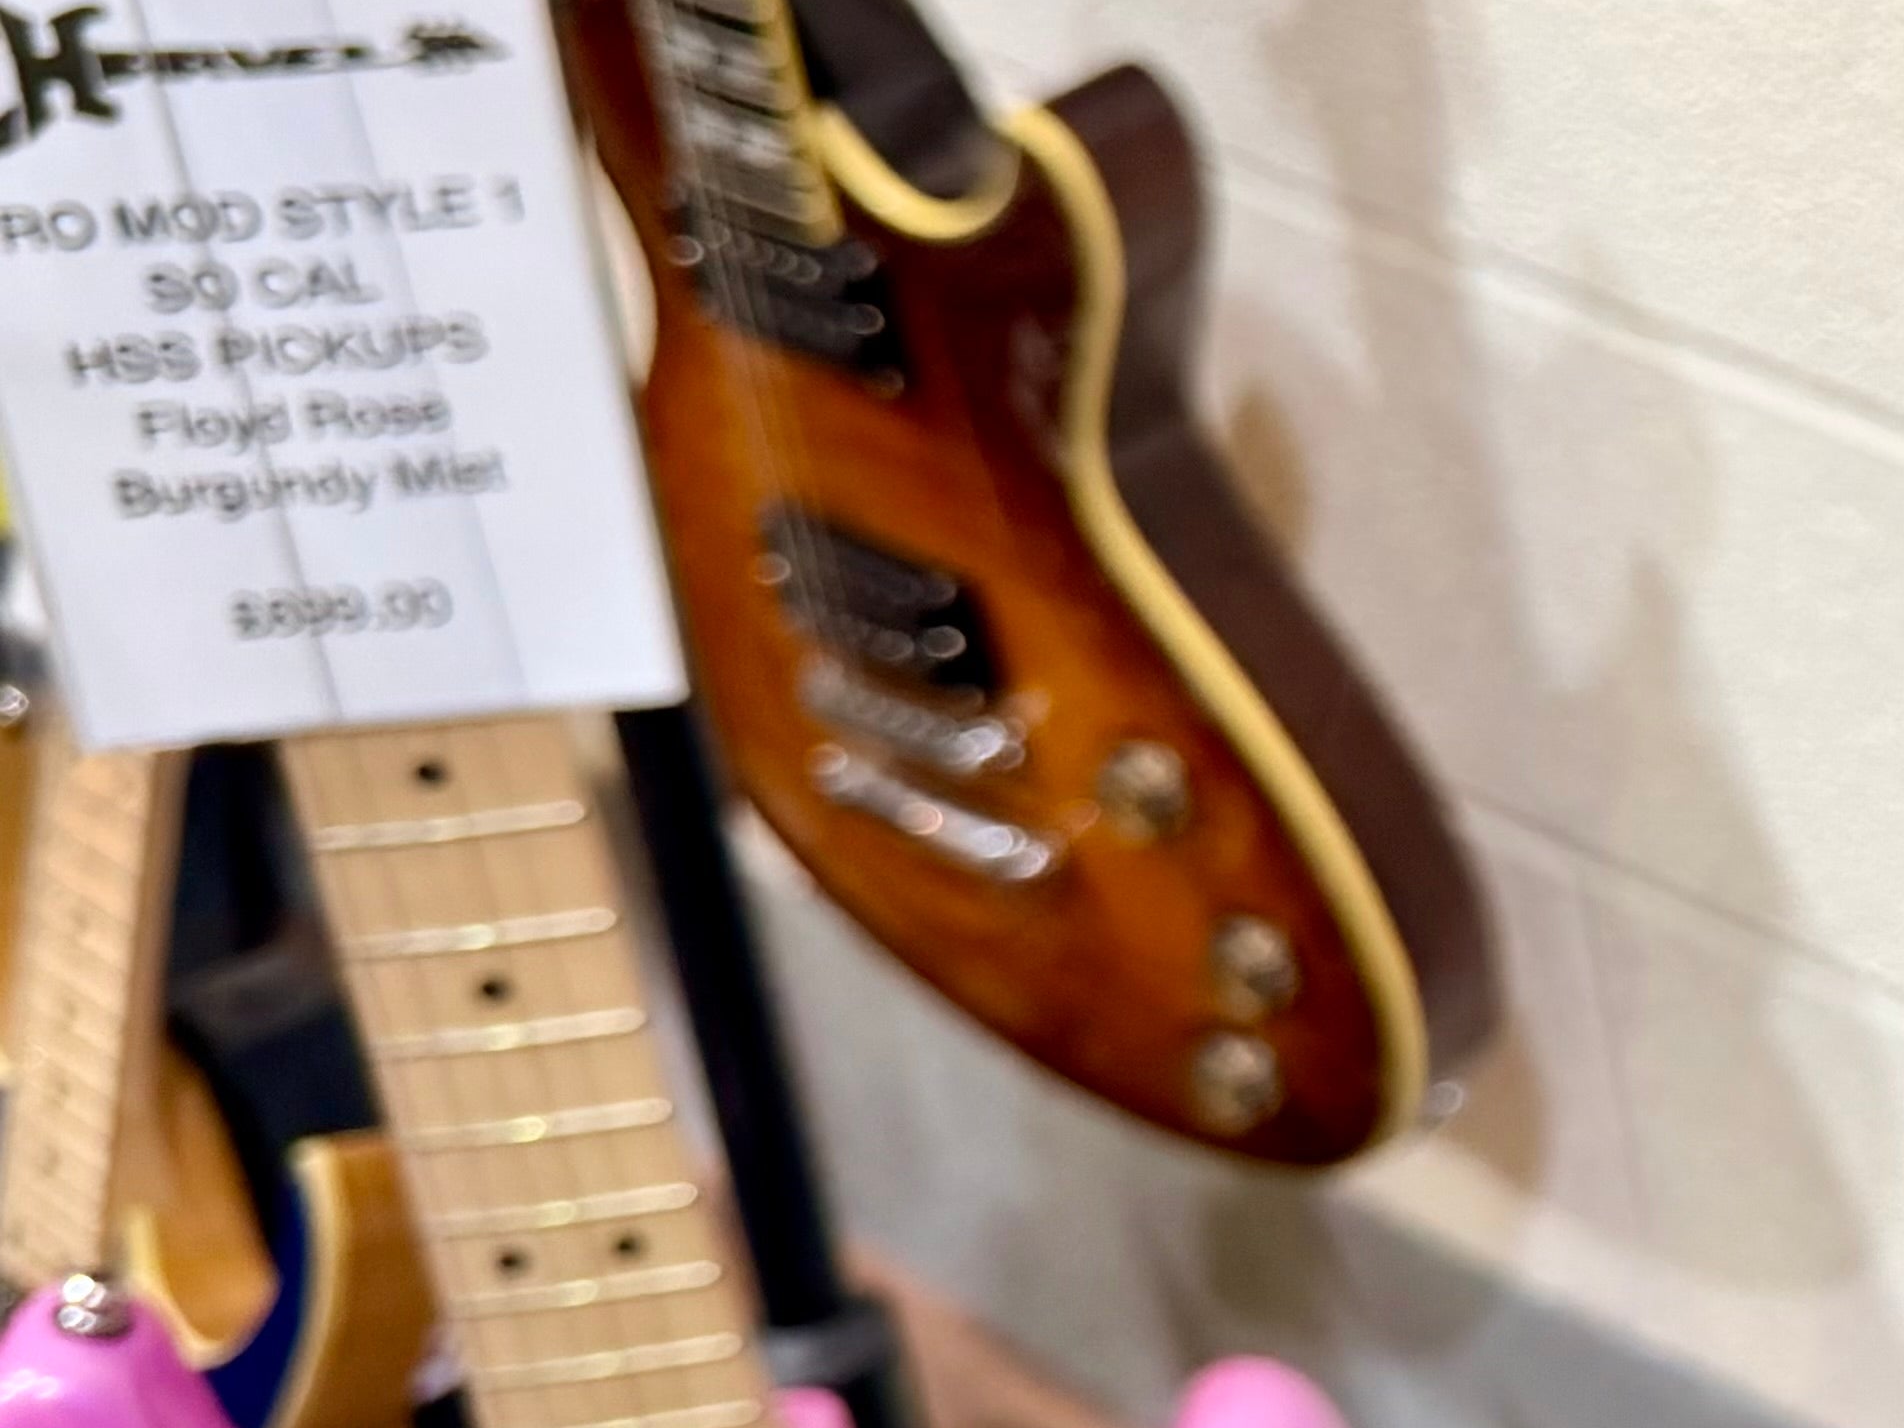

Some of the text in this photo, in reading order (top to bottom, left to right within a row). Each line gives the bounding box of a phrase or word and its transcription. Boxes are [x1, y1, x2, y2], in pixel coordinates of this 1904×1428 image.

[110, 188, 263, 245] MOD
[278, 172, 483, 240] STYLE
[144, 257, 385, 314] SO CAL
[65, 310, 490, 387] HSS PICKUPS
[136, 390, 453, 454] Floyd Rose
[112, 460, 377, 522] Burgundy
